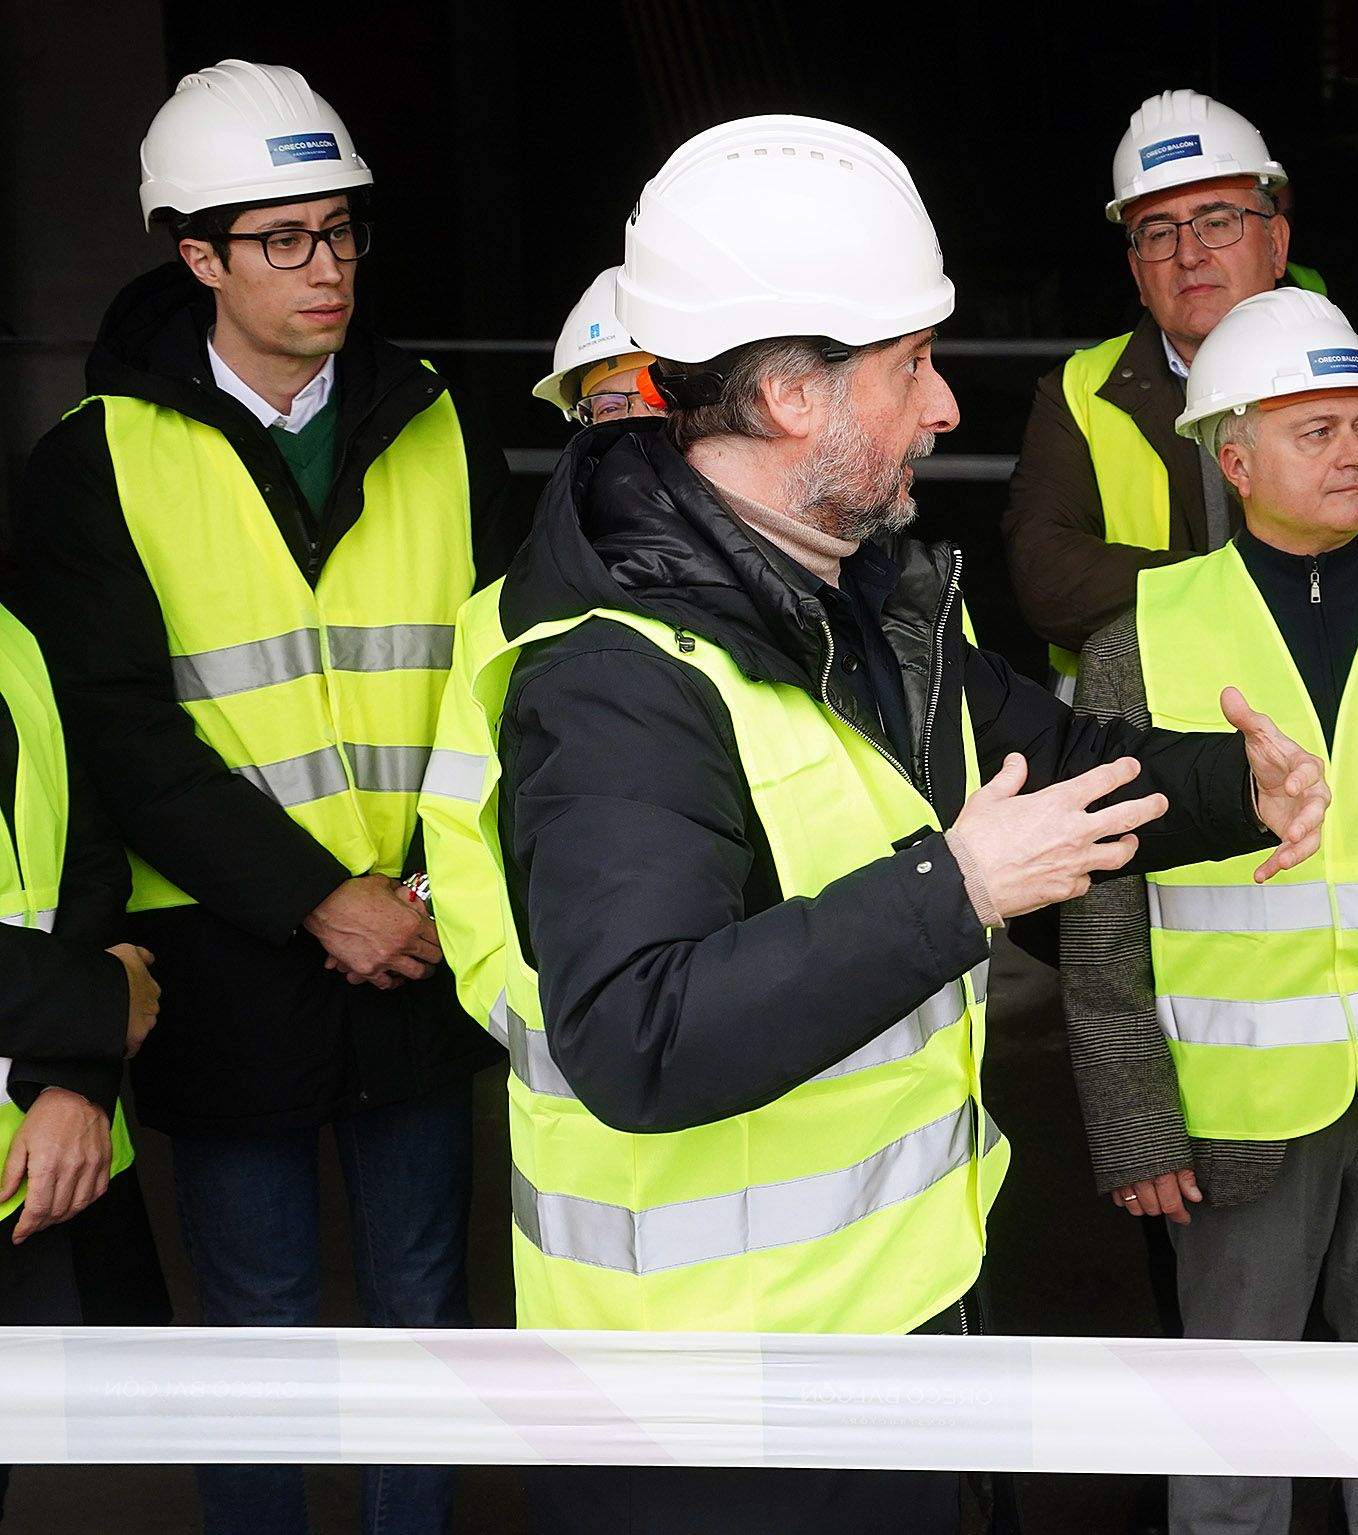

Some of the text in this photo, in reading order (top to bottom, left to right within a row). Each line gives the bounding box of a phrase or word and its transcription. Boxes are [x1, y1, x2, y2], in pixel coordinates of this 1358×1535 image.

[279, 141, 305, 152] ORECO
[1146, 140, 1194, 158] ORECO BALCÓN
[1318, 355, 1341, 364] ORECO
